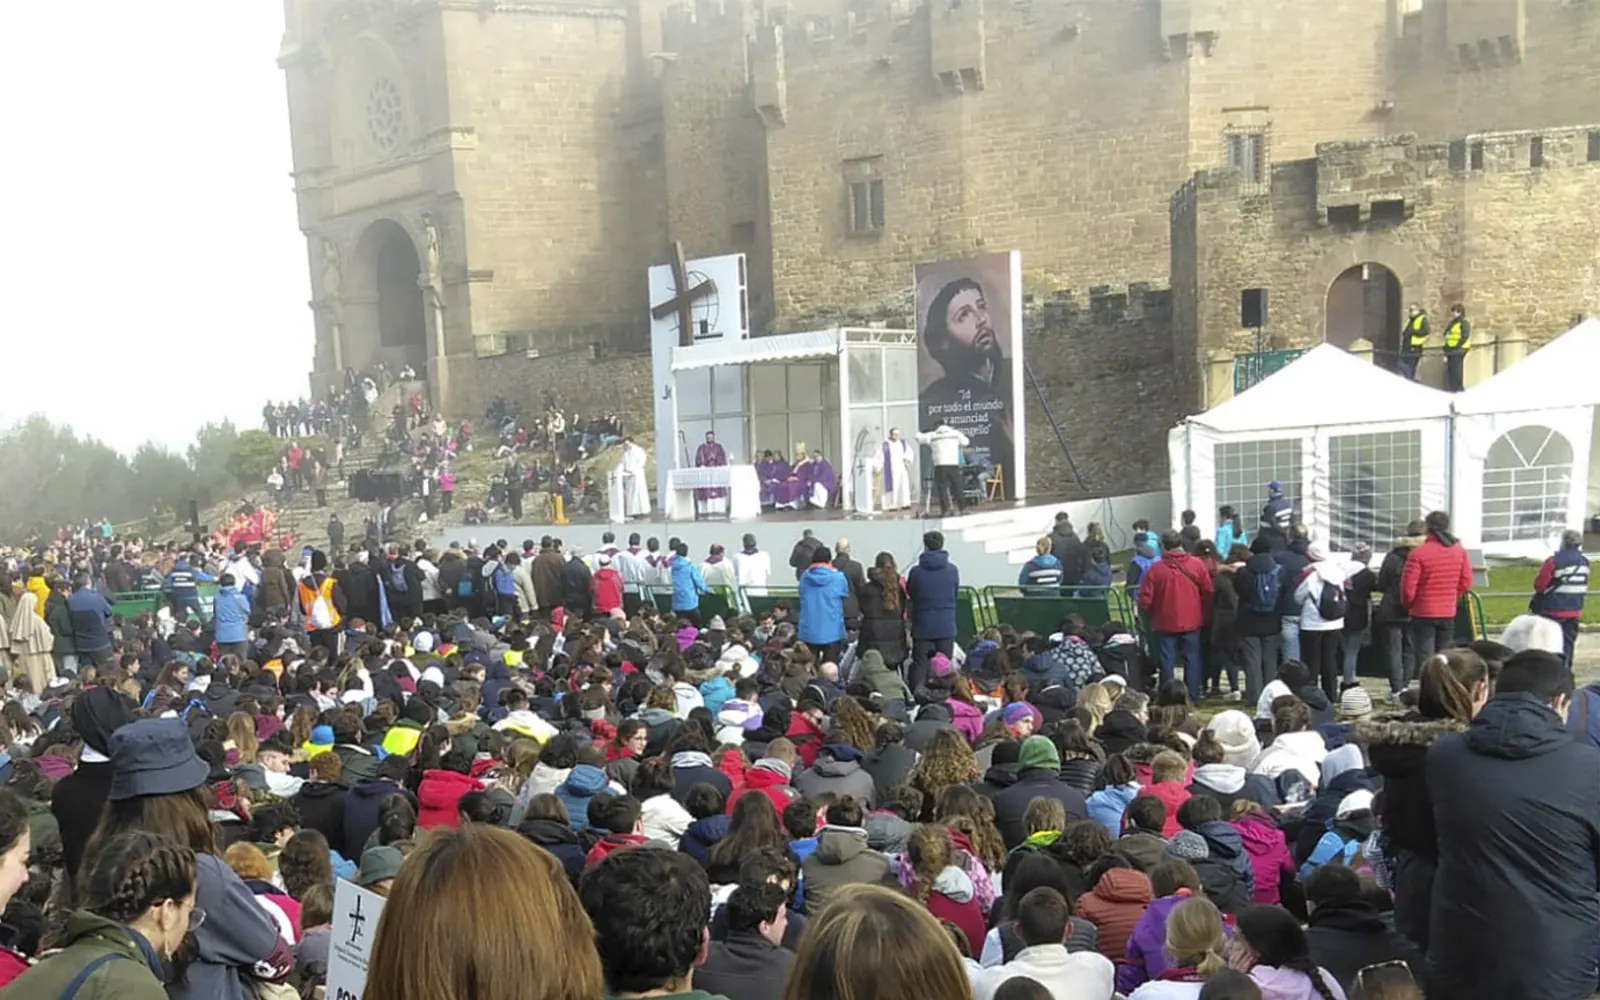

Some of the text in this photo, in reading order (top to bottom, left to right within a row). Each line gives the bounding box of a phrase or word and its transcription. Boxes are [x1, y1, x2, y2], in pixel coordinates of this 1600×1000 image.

[928, 399, 1004, 416] por todo el mundo
[950, 412, 989, 424] anunciad
